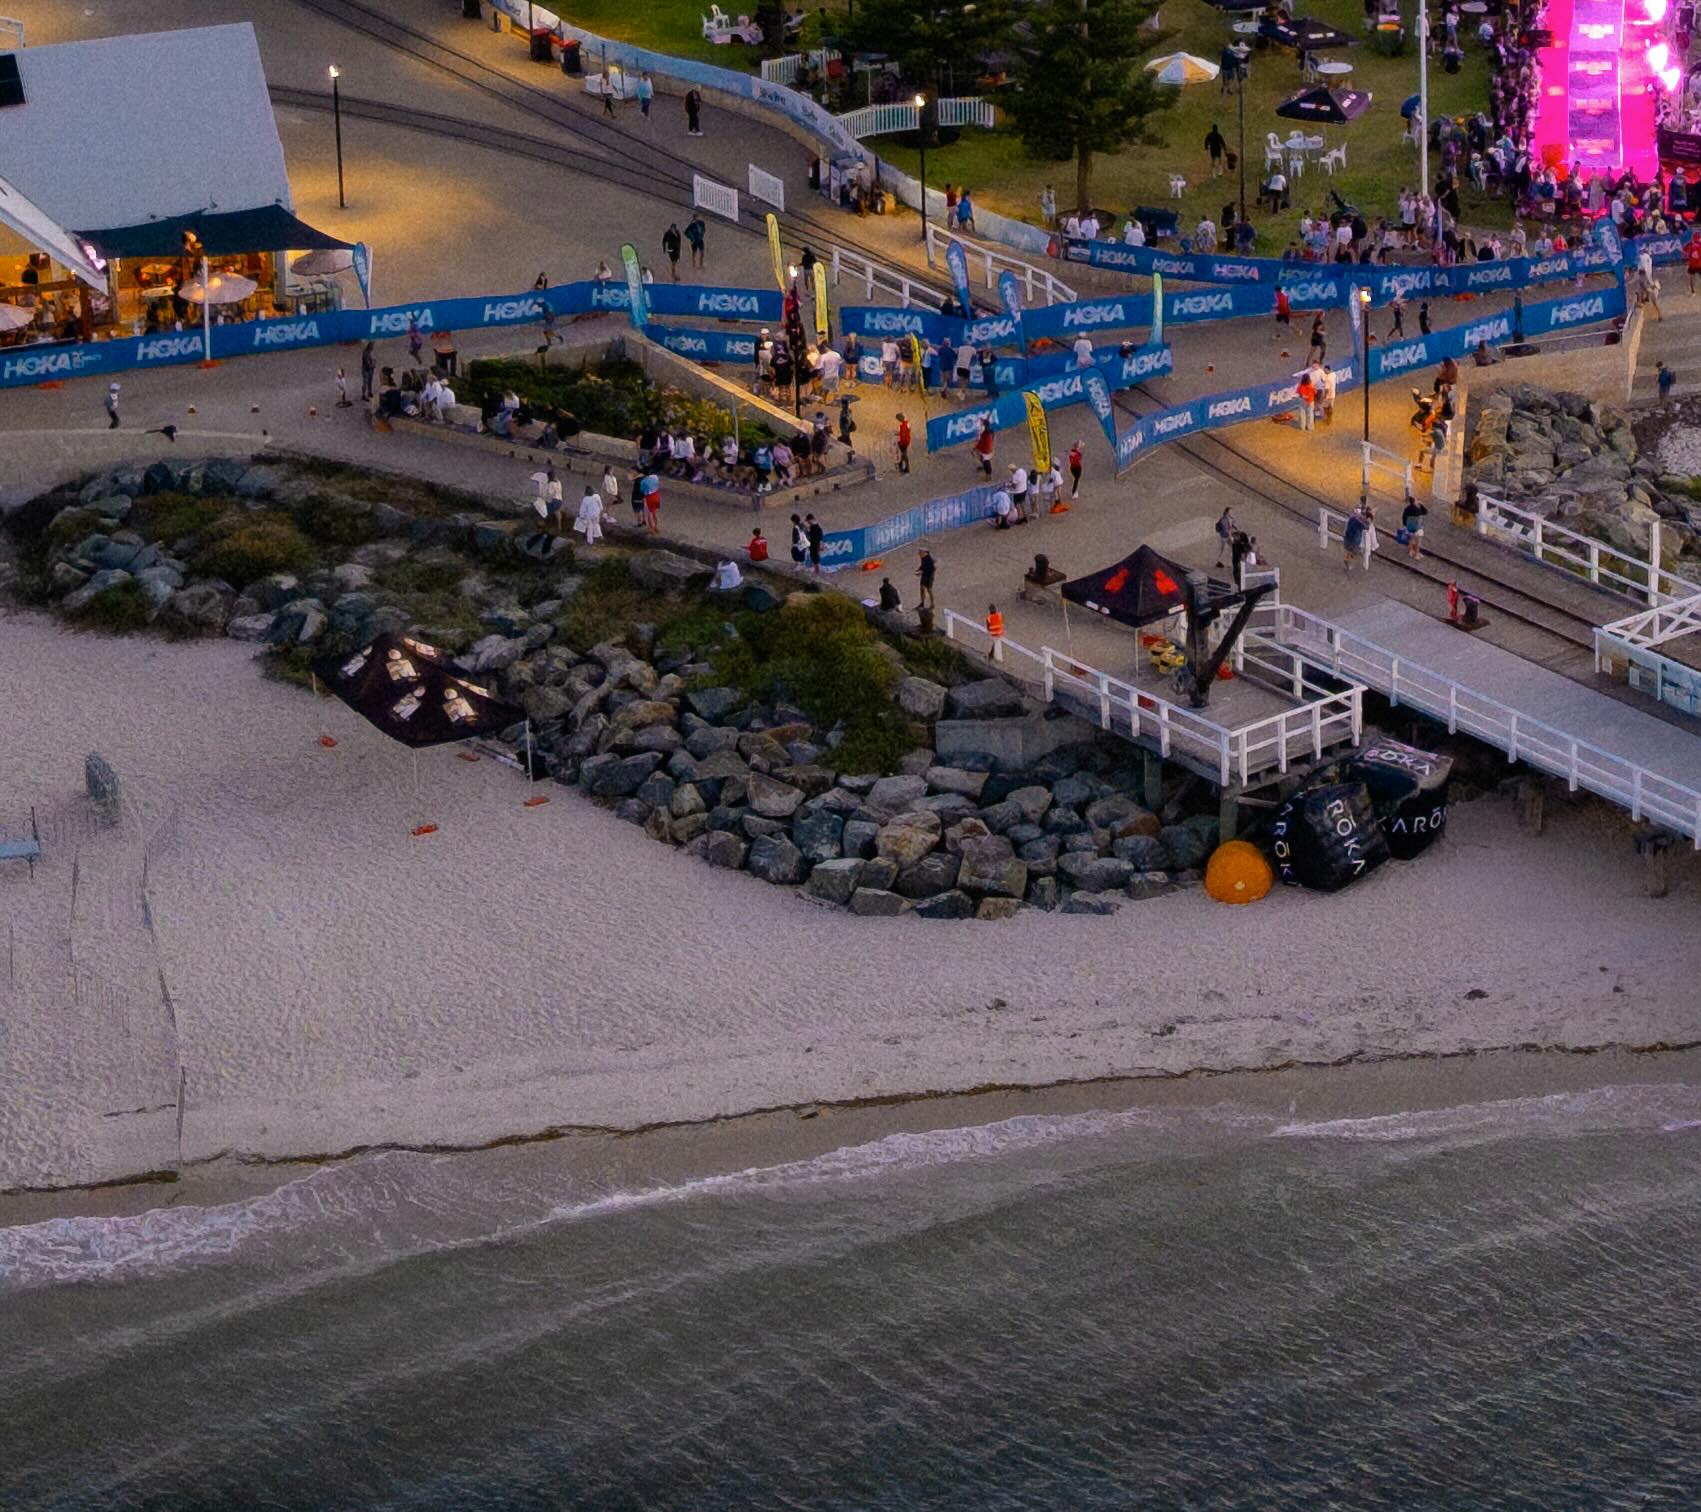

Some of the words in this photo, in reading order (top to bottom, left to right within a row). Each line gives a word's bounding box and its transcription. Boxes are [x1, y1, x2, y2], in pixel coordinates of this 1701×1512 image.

[1095, 247, 1137, 267] HOKA
[1152, 257, 1195, 274] HOKA
[1528, 258, 1569, 277] HOKA
[1213, 262, 1259, 281] HOKA
[1381, 271, 1431, 294] HOKA
[1467, 266, 1512, 286] HOKA
[699, 293, 760, 314] HOKA
[1172, 292, 1233, 316] HOKA
[1550, 296, 1605, 326] HOKA
[864, 311, 924, 335] HOKA
[1063, 304, 1125, 328] HOKA
[253, 320, 321, 347] HOKA
[663, 335, 708, 353] HOKA
[1463, 317, 1511, 350] HOKA
[136, 336, 203, 361] HOKA
[1379, 342, 1428, 373] HOKA
[4, 352, 73, 379] HOKA
[1122, 348, 1173, 380] HOKA
[1208, 396, 1252, 419] HOKA
[1153, 411, 1194, 437] HOKA
[821, 539, 854, 559] OKA
